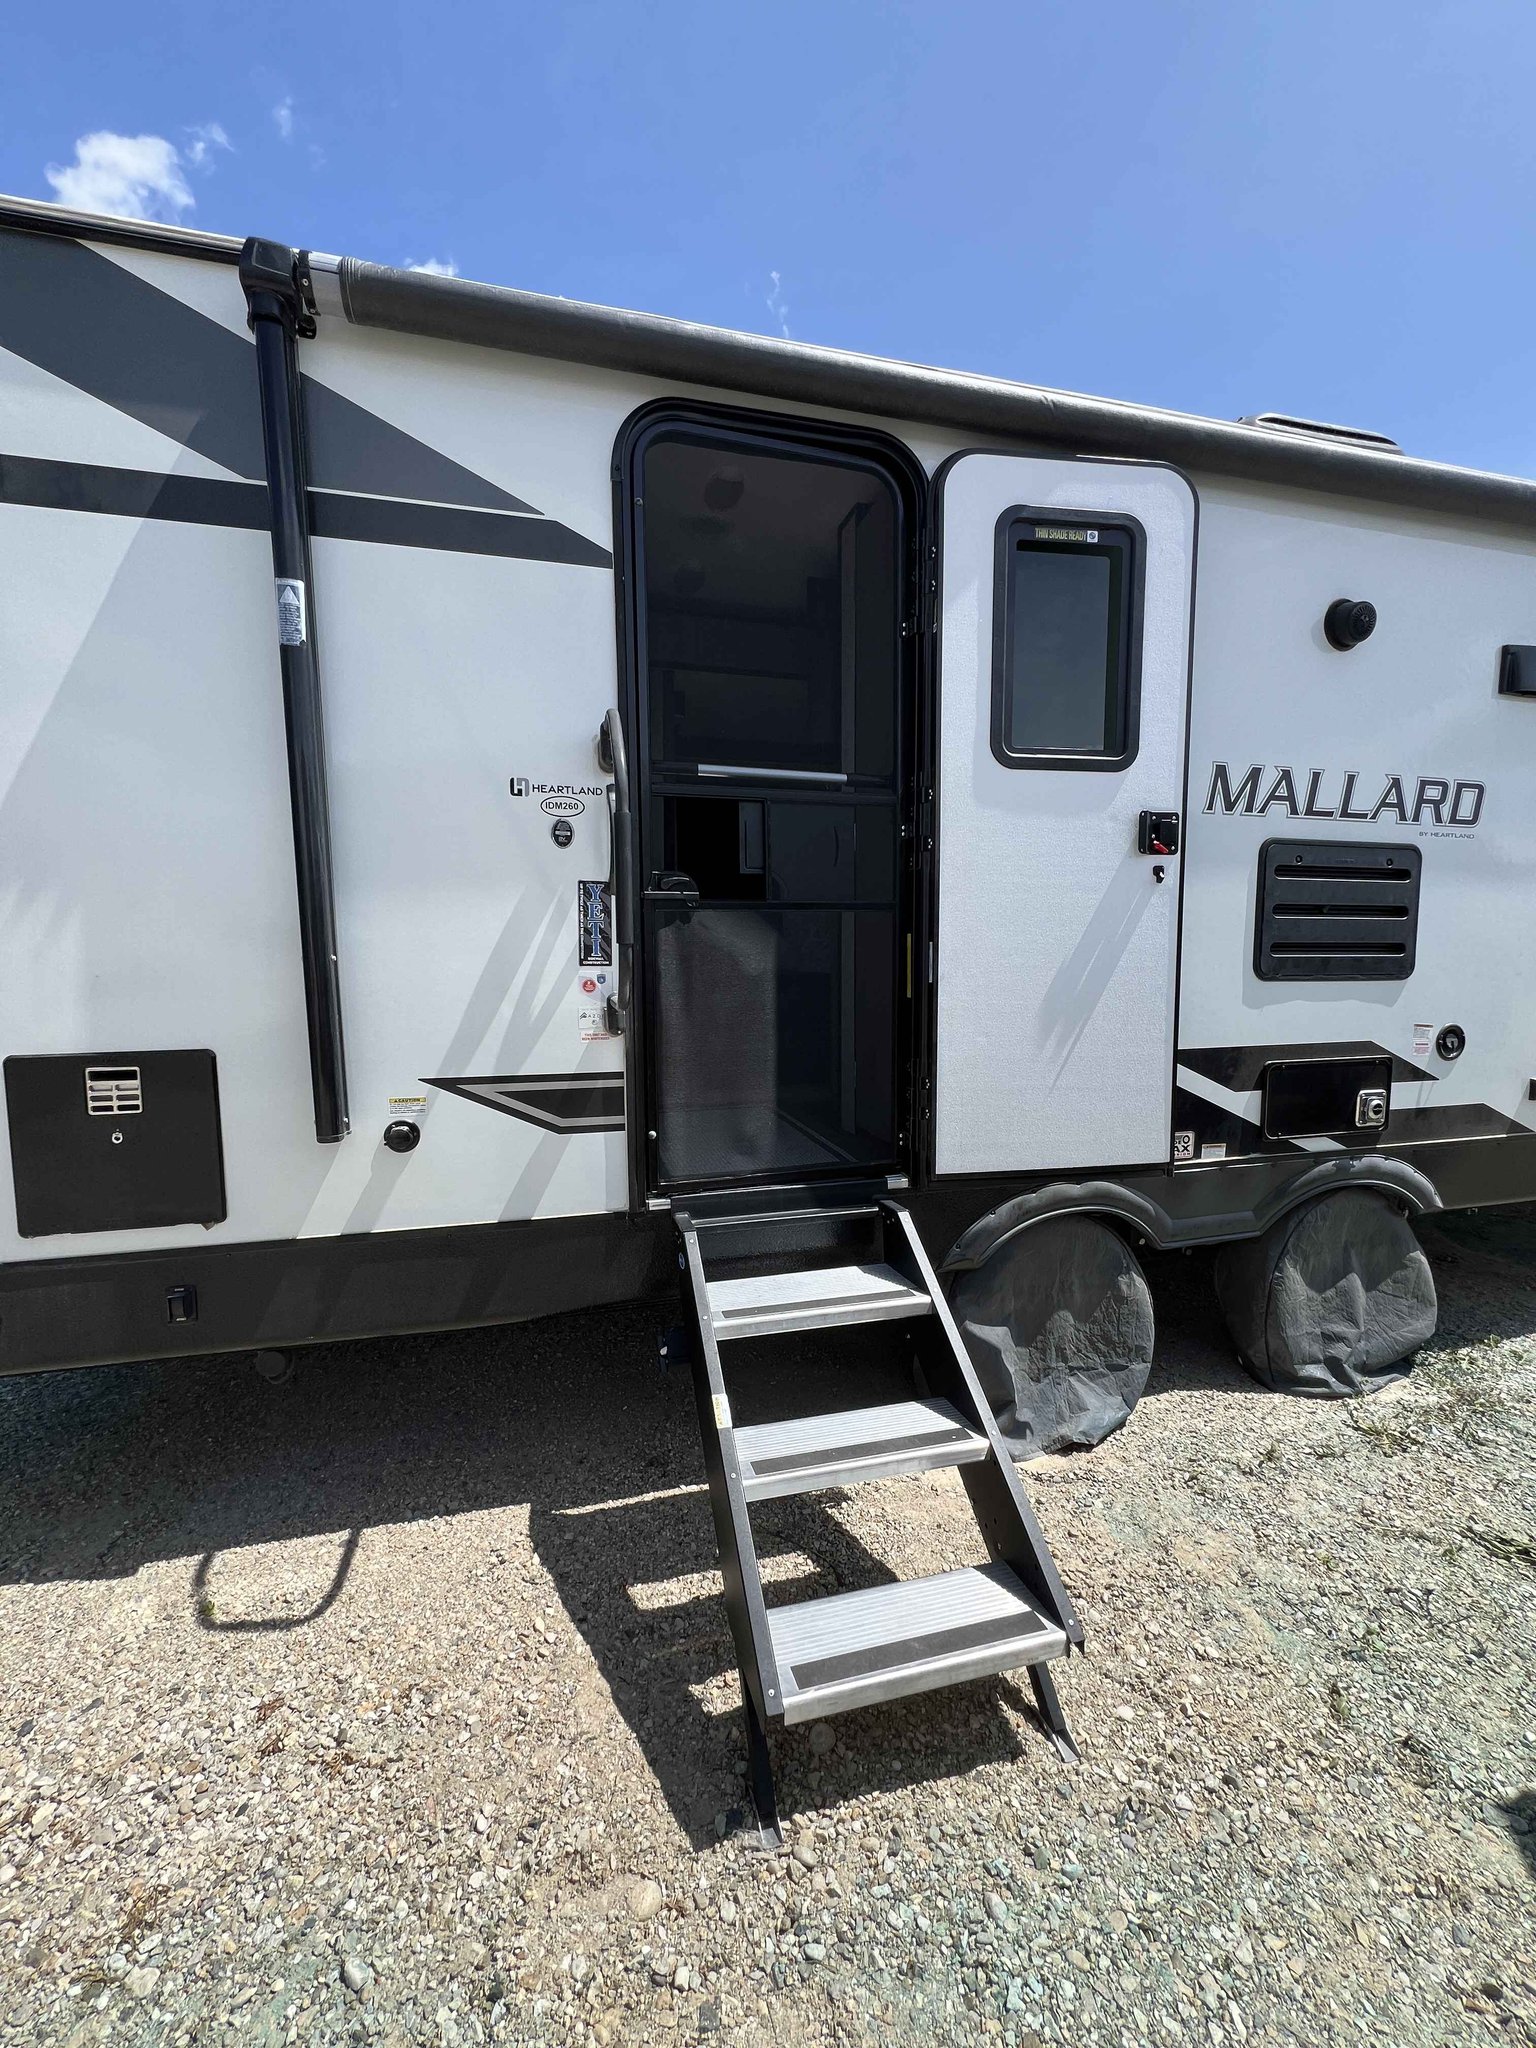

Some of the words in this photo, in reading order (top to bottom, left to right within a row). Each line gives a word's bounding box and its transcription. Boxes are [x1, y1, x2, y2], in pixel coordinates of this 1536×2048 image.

[1035, 527, 1049, 538] THIN
[1050, 529, 1068, 540] SHADE
[1069, 530, 1086, 541] READY
[532, 784, 603, 796] HEARTLAND
[1202, 760, 1486, 828] MALLARD
[545, 802, 579, 810] IDM260
[1430, 831, 1475, 839] HEARTLAND
[586, 883, 605, 957] YETI
